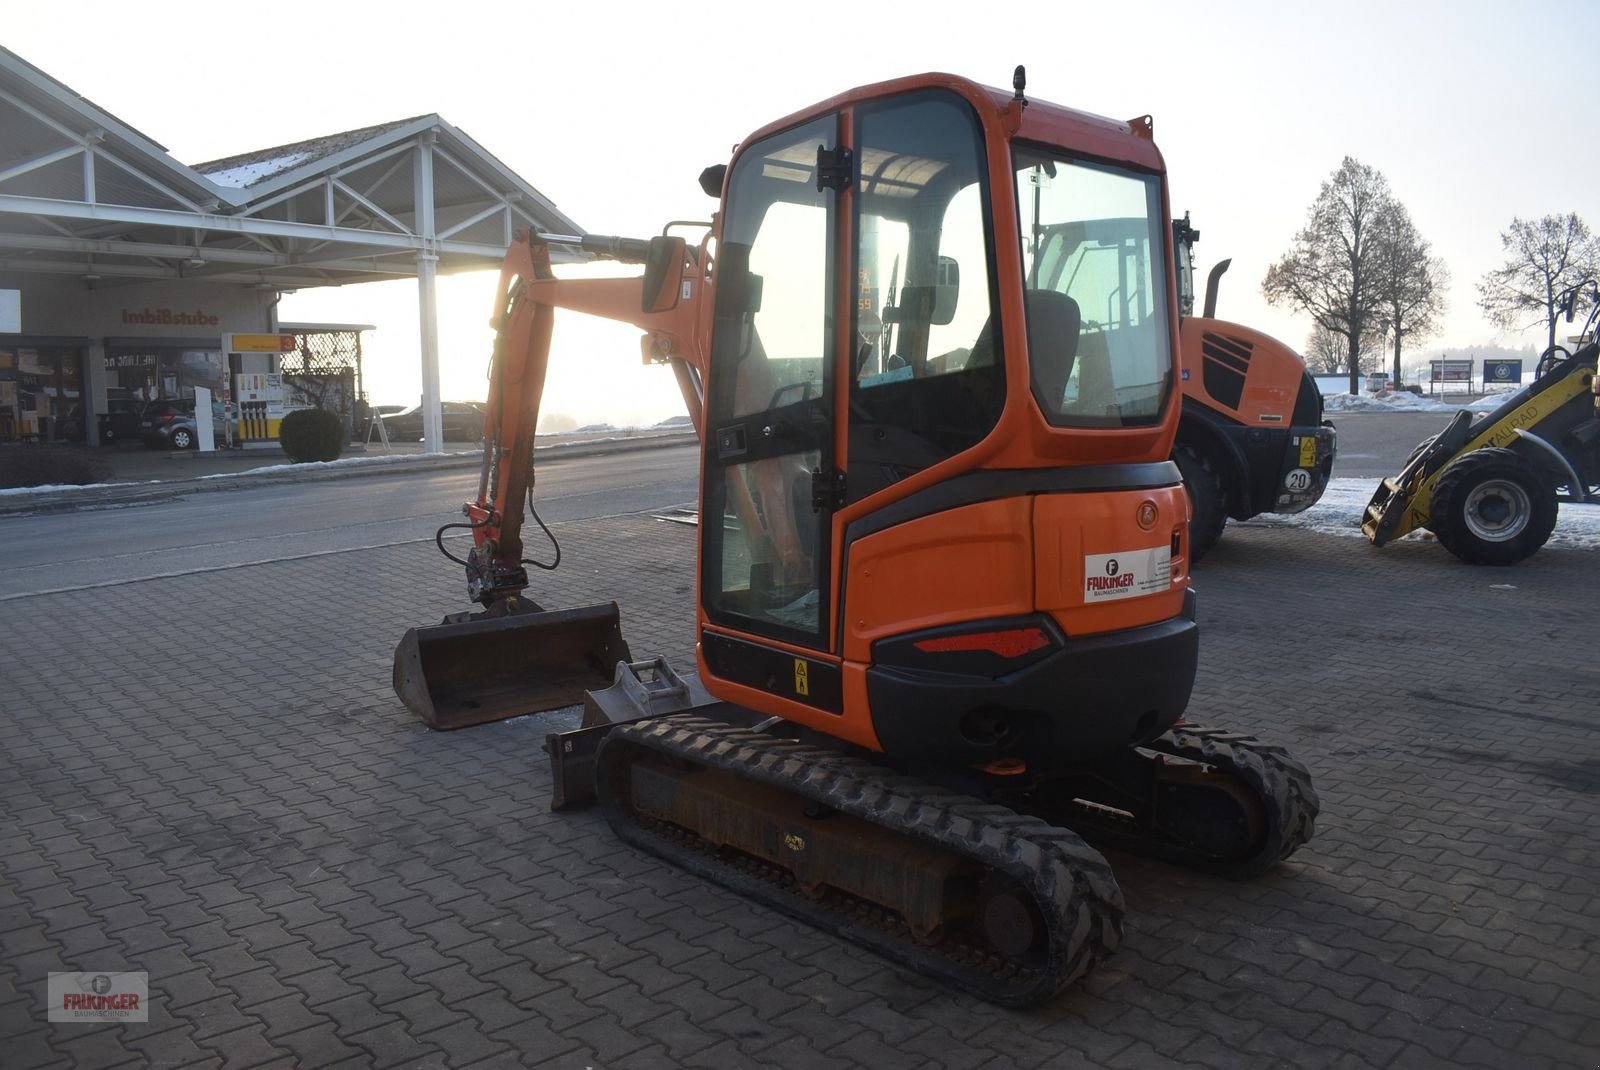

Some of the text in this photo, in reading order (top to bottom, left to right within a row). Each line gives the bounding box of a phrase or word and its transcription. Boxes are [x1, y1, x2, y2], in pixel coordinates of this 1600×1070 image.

[122, 308, 219, 326] Imbißstube
[1289, 473, 1306, 489] 20
[1107, 560, 1117, 575] F
[1087, 573, 1134, 592] FALKINGER
